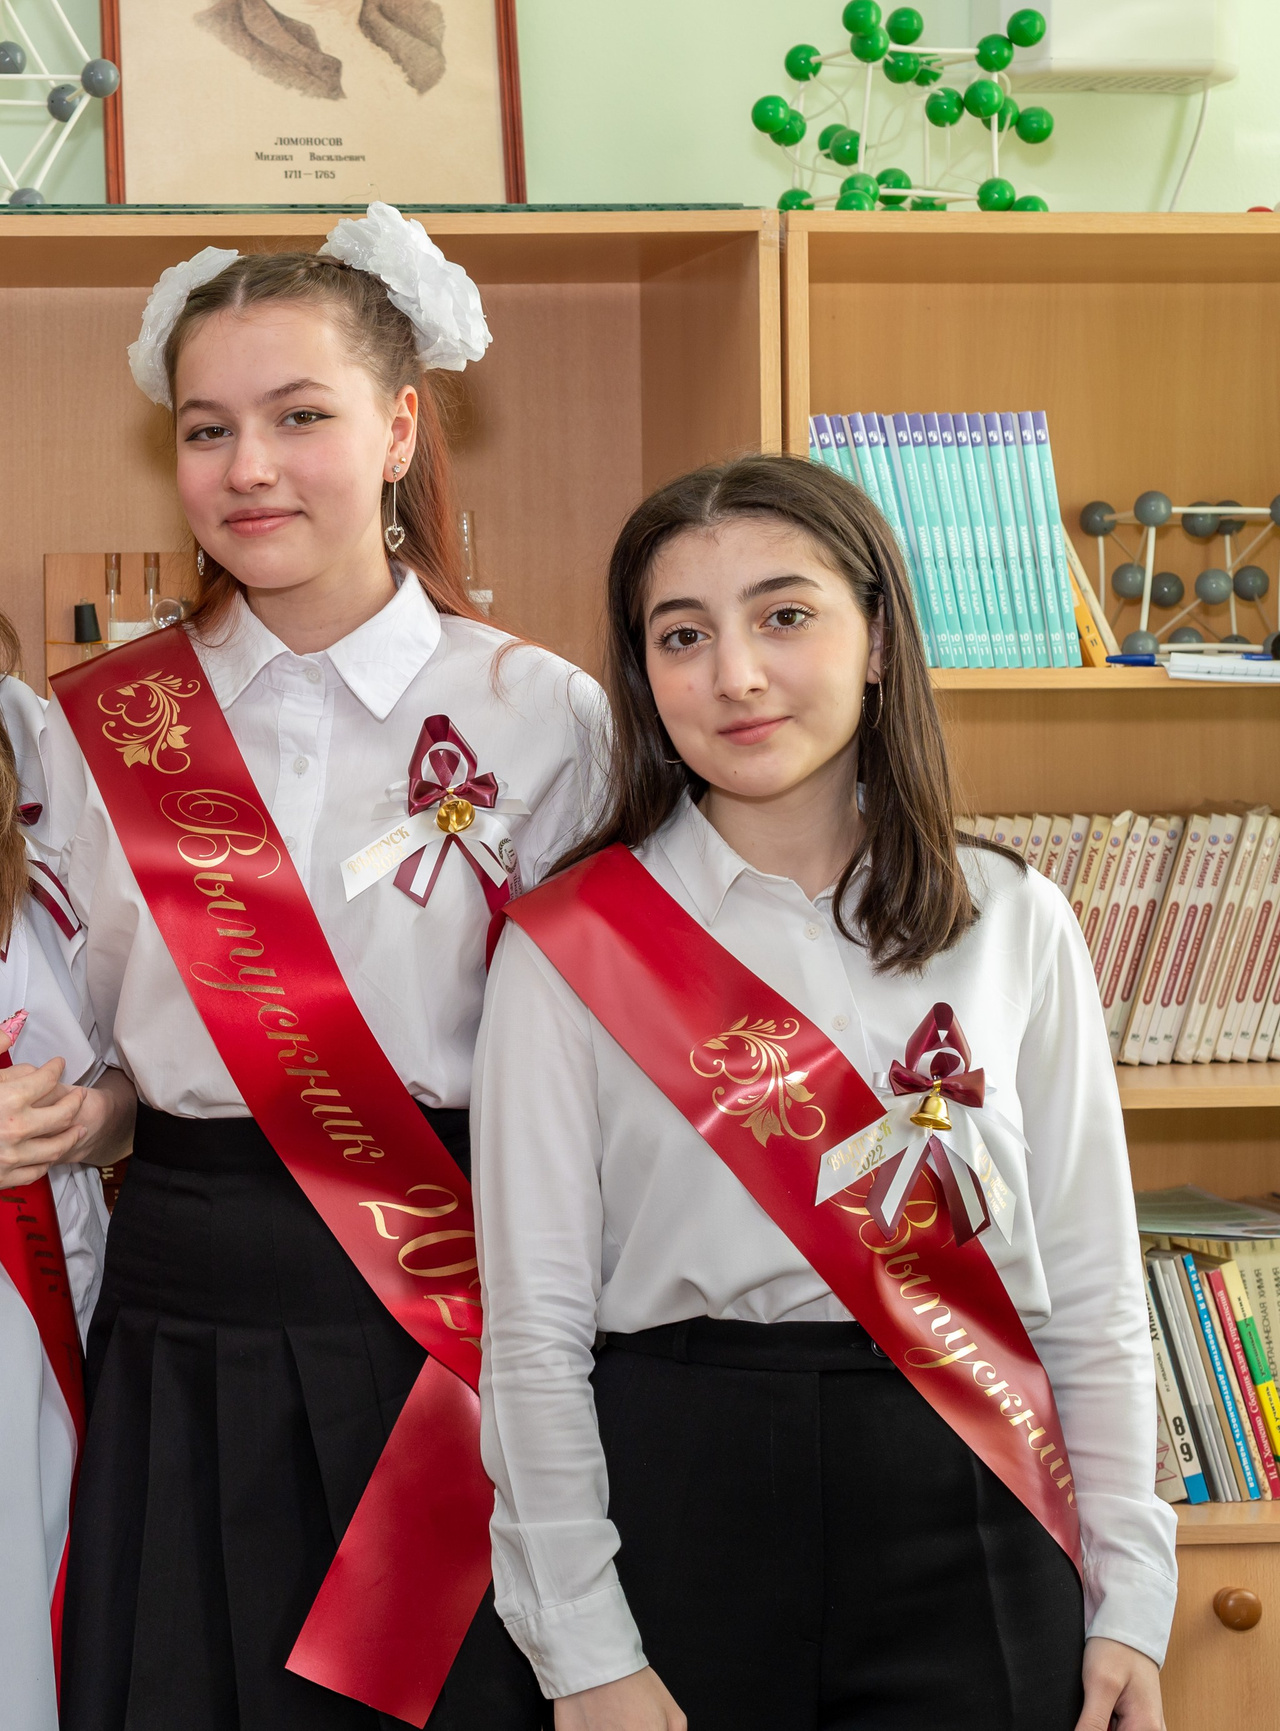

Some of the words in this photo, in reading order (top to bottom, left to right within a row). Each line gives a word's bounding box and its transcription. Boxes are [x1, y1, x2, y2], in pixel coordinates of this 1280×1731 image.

[255, 151, 293, 161] Михаил
[309, 151, 366, 161] Васильевич
[274, 137, 343, 146] ЛОМОНОСОВ
[918, 526, 930, 558] ХИМИЯ
[932, 526, 944, 558] ХИМИЯ
[947, 526, 959, 558] ХИМИЯ
[960, 527, 972, 558] ХИМИЯ
[975, 526, 987, 558] ХИМИЯ
[989, 526, 1001, 558] ХИМИЯ
[1005, 526, 1016, 558] ХИМИЯ
[1020, 525, 1031, 557] ХИМИЯ
[1037, 525, 1048, 557] ХИМИЯ
[1052, 524, 1063, 556] ХИМИЯ
[348, 826, 410, 875] ВЫПУСК
[371, 844, 408, 876] 2022
[1060, 847, 1079, 886] Химия
[1081, 846, 1099, 885] Химия
[1119, 848, 1137, 886] Химия
[1155, 845, 1173, 883] Химия
[1178, 847, 1197, 886] Химия
[1196, 850, 1216, 889] Химия
[1211, 849, 1230, 887] Химия
[1099, 852, 1117, 891] Химия
[1137, 851, 1156, 889] Химия
[160, 789, 385, 1166] Выпускник
[826, 1118, 892, 1171] ВЫПУСК
[851, 1144, 887, 1176] 2022
[1217, 1289, 1240, 1343] упражнений
[1188, 1265, 1206, 1310] ХИМИЯ
[1204, 1320, 1222, 1373] Проектная
[1217, 1373, 1241, 1439] деятельность
[1236, 1441, 1255, 1488] учащихся
[1236, 1351, 1249, 1375] задач
[1243, 1375, 1259, 1414] Сборник
[1255, 1415, 1272, 1459] Хомченко
